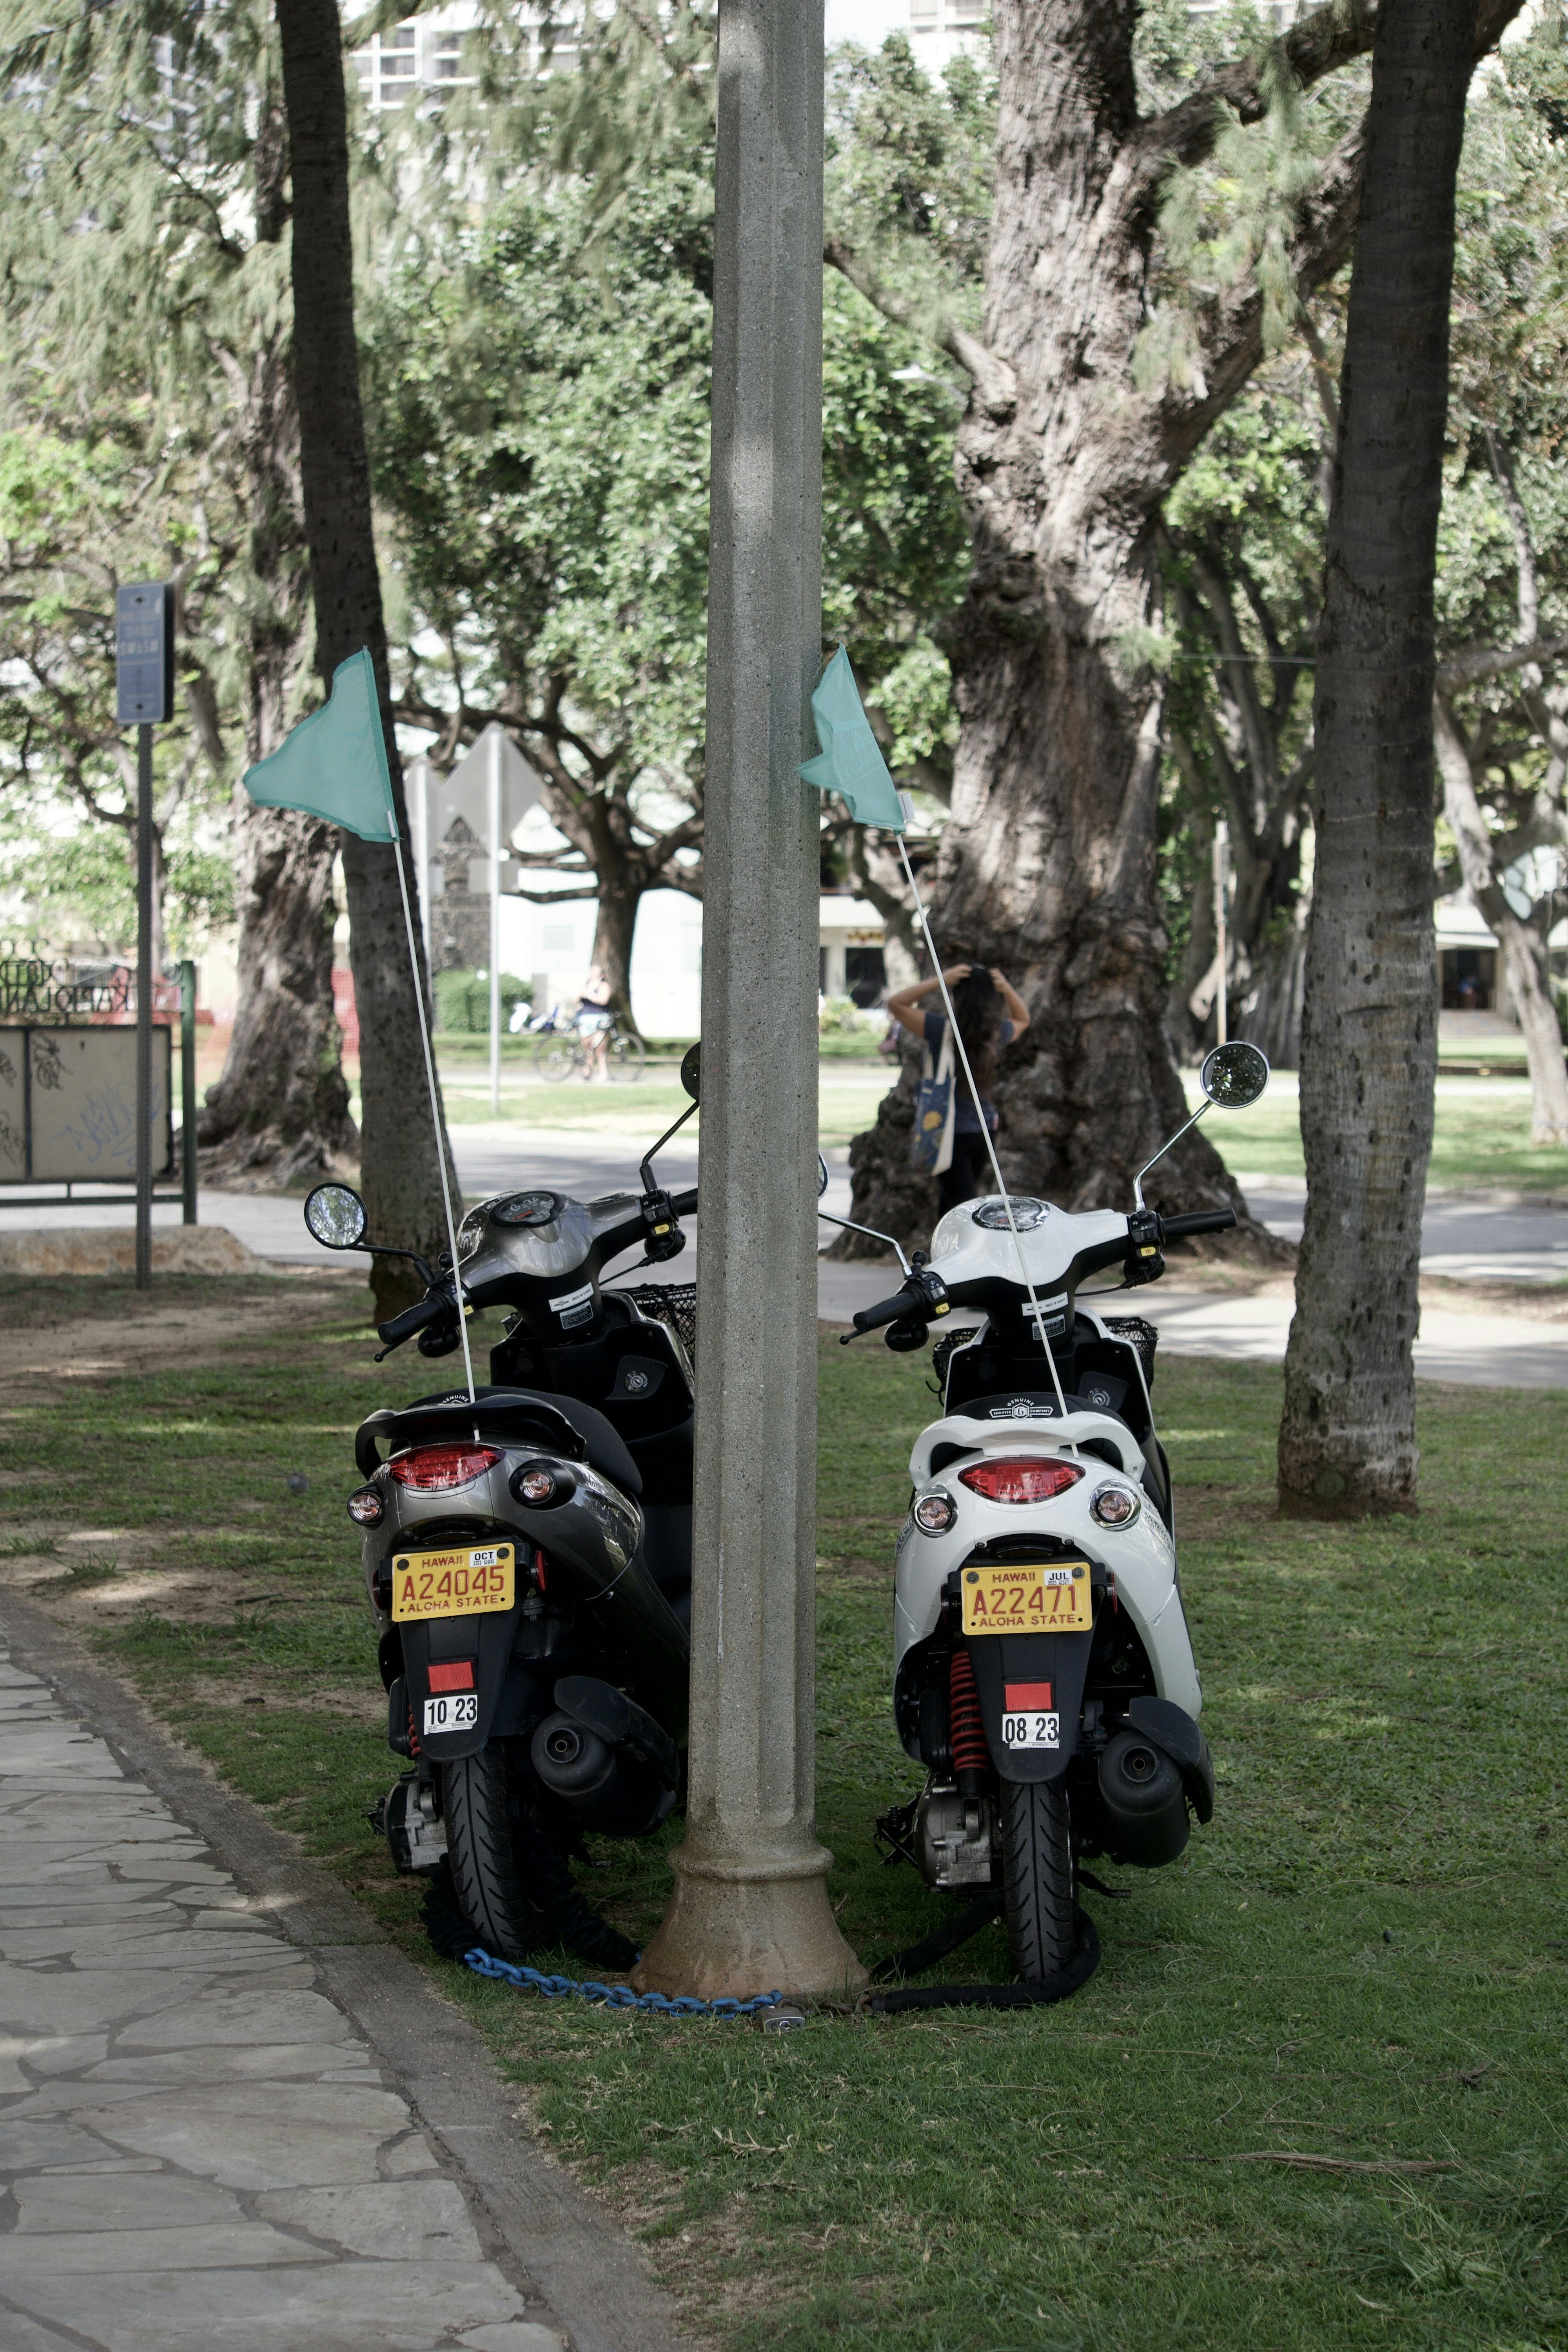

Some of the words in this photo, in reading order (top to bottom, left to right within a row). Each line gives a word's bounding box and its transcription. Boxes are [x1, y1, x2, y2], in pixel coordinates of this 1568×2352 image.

[442, 1395, 469, 1404] GENUINE
[1007, 1398, 1034, 1406] GENUINE
[422, 1555, 464, 1568] HAWAII
[474, 1551, 494, 1561] OCT
[402, 1566, 505, 1602] A24045
[993, 1572, 1036, 1583] HAWAII
[408, 1600, 450, 1613] ALOHA
[457, 1595, 498, 1608] STATE
[973, 1585, 1076, 1616] A22471
[980, 1617, 1025, 1627] ALOHA
[1031, 1614, 1075, 1625] STATE
[428, 1700, 447, 1725] 10
[456, 1697, 477, 1722] 23
[1005, 1718, 1027, 1742] 08
[1036, 1717, 1058, 1741] 23
